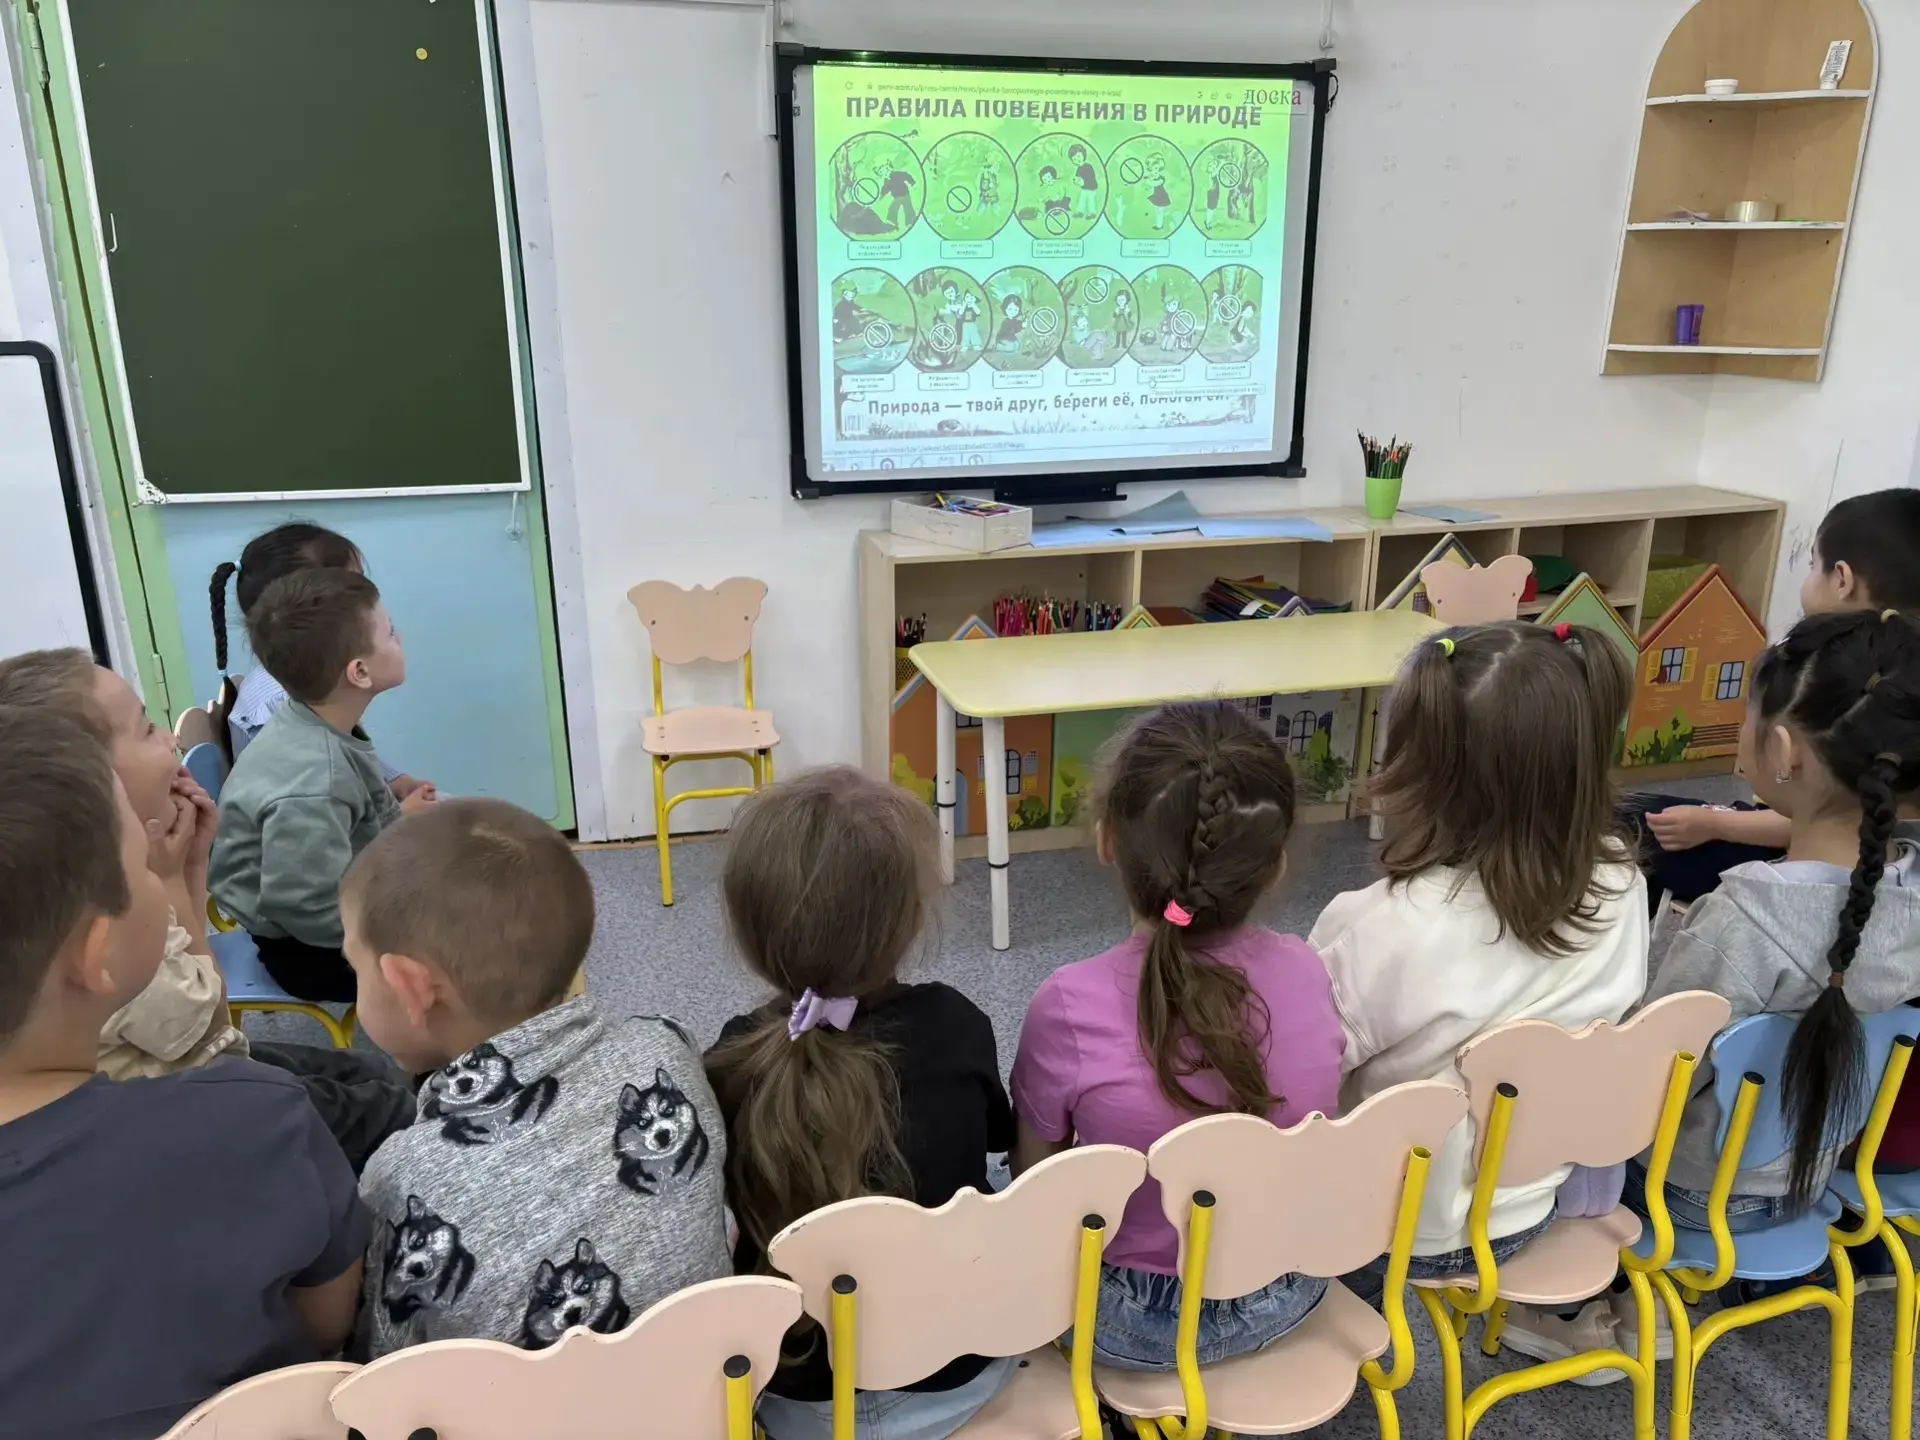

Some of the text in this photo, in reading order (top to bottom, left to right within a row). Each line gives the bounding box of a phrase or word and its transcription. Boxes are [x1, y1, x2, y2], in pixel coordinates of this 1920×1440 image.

[846, 97, 1262, 129] ПРАВИЛА ПОВЕДЕНИЯ В ПРИРОДЕ
[868, 400, 940, 416] Природа
[966, 397, 1003, 411] твой
[1008, 398, 1048, 414] друг,
[1113, 391, 1134, 407] её,
